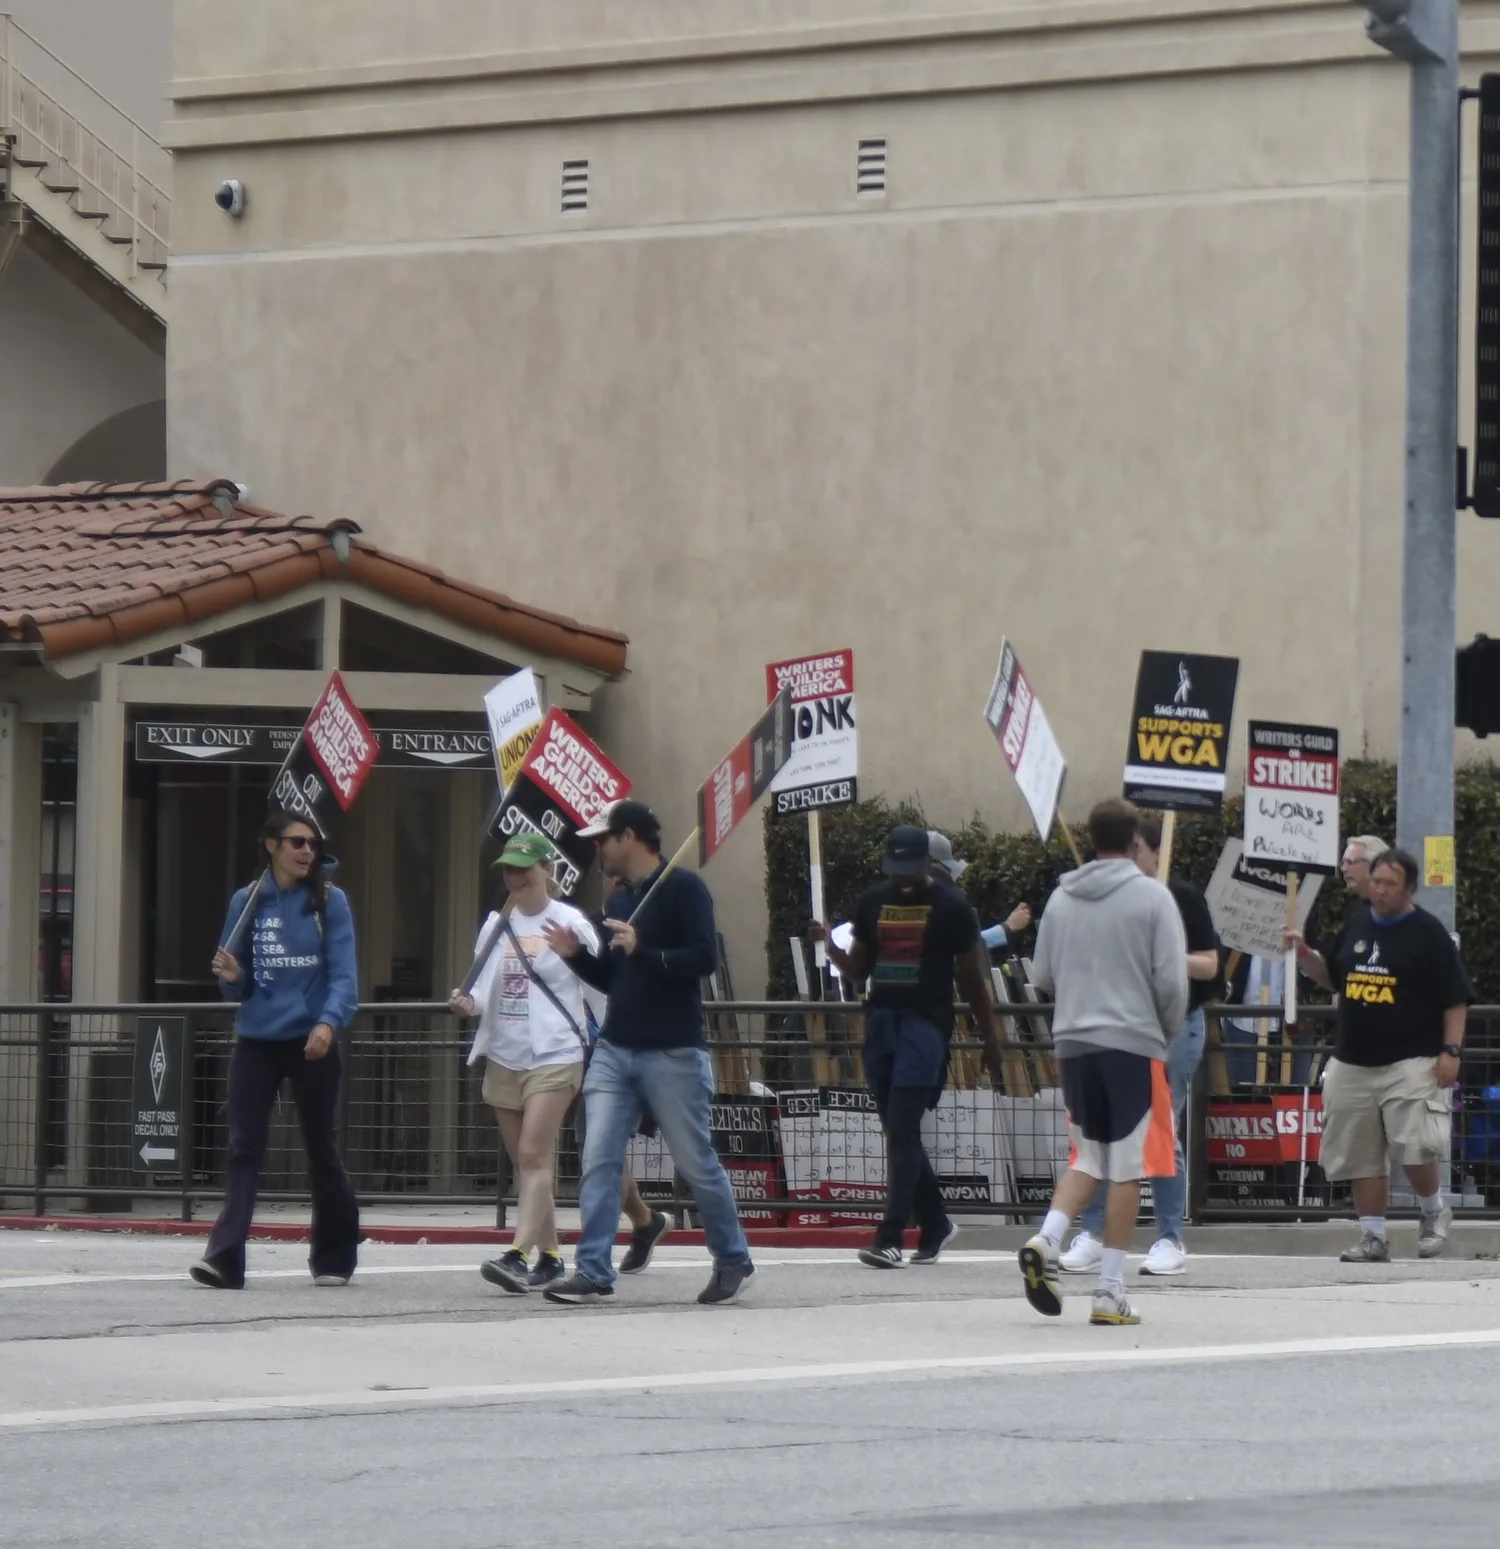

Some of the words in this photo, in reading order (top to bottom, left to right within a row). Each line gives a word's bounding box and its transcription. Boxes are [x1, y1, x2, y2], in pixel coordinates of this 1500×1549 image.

[774, 655, 844, 679] WRITERS
[777, 671, 824, 691] GUILD
[824, 669, 842, 680] OF
[789, 679, 847, 700] MERICA
[327, 684, 369, 762] WRITERS
[1138, 716, 1224, 739] SUPPORTS
[147, 727, 195, 744] EXIT
[202, 728, 255, 746] ONLY
[319, 704, 351, 759] GUILD
[345, 755, 358, 774] OF
[392, 733, 491, 752] ENTRANC
[1254, 729, 1303, 745] WRITERS
[1304, 734, 1334, 751] GUILD
[308, 719, 352, 799] AMERICA
[549, 719, 619, 798] WRITERS
[1136, 732, 1220, 768] WGA
[542, 741, 593, 796] GUILD
[1252, 757, 1333, 792] STRIKE!
[303, 774, 322, 803] ON
[777, 780, 851, 813] STRIKE
[541, 809, 566, 841] ON
[499, 804, 581, 897] STKE
[1345, 982, 1395, 1005] WGA
[137, 1111, 156, 1122] FAST
[157, 1111, 176, 1122] PASS
[134, 1124, 158, 1136] DECAL
[159, 1125, 180, 1136] ONLY
[728, 1135, 744, 1153] ON
[1226, 1144, 1246, 1158] ON
[829, 1187, 888, 1200] MERICA
